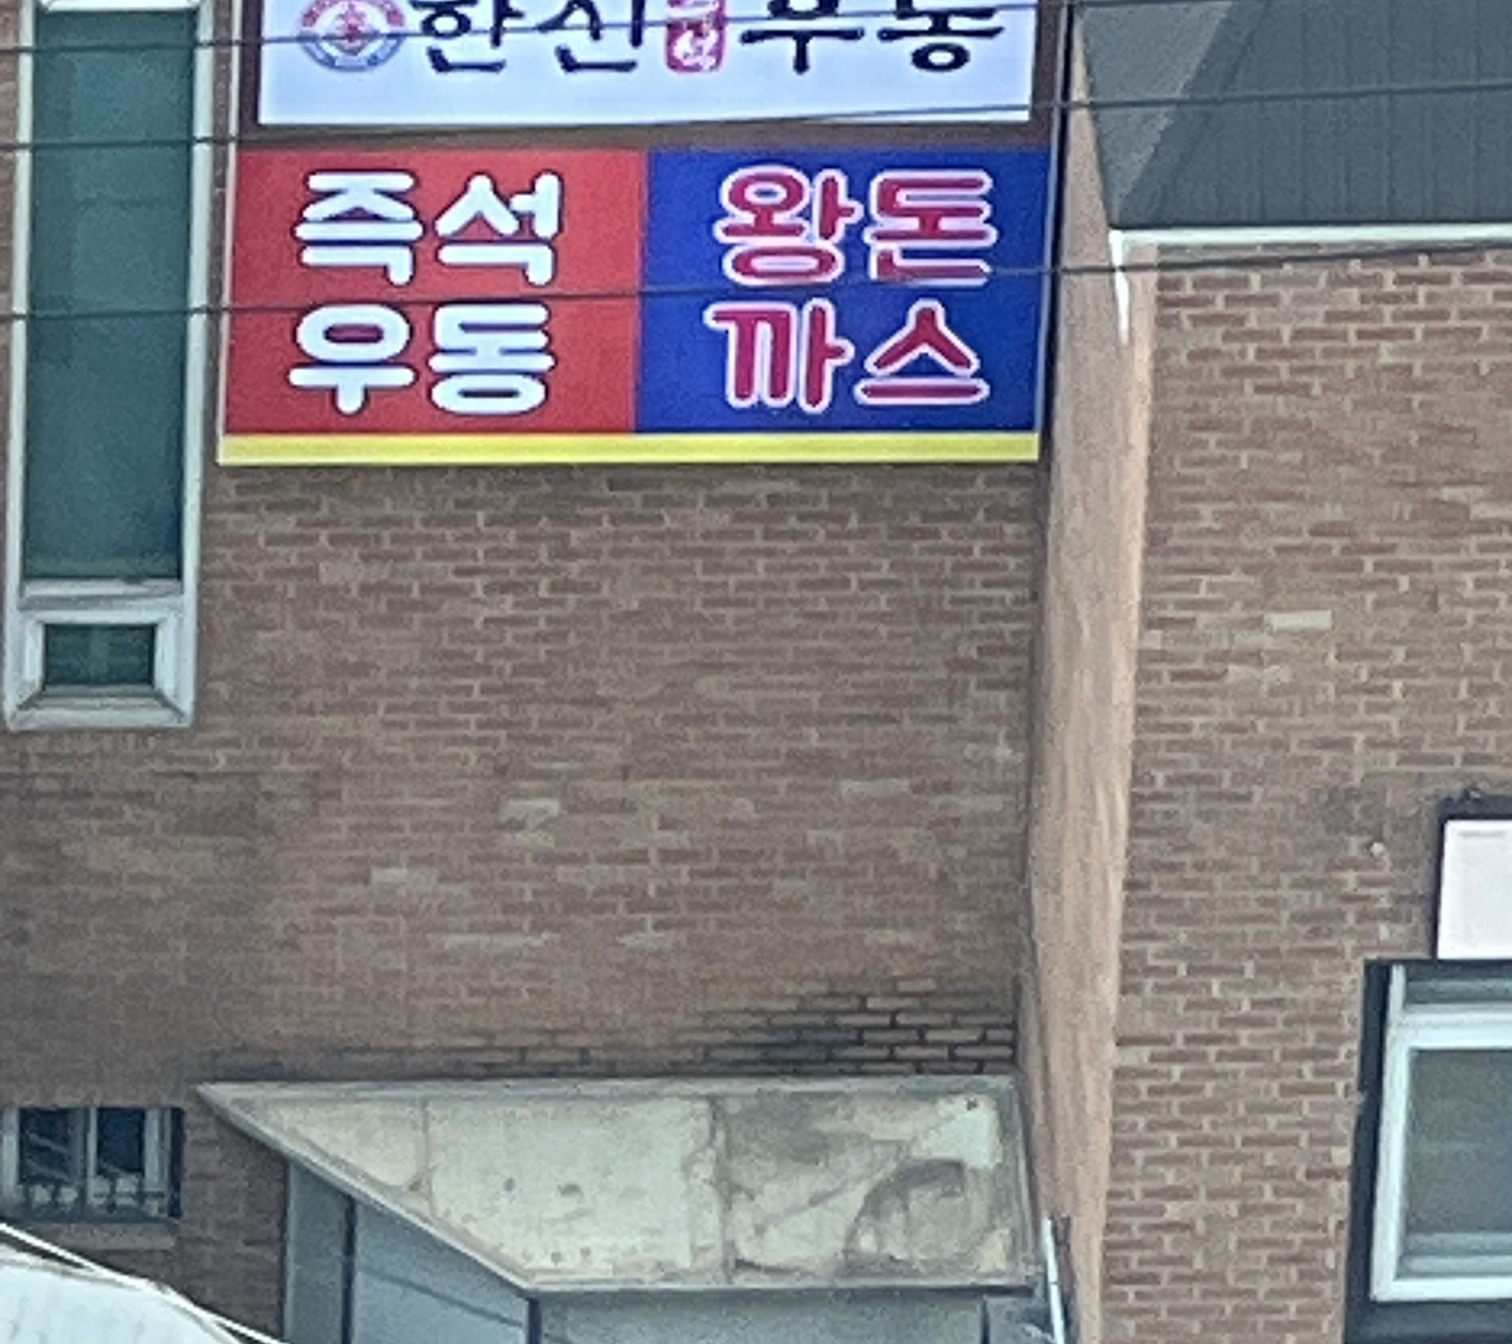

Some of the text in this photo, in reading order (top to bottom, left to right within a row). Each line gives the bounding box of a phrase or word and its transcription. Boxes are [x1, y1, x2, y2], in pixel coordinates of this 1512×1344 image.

[294, 167, 565, 287] 즉석
[713, 162, 999, 287] 왕돈
[287, 301, 557, 417] 우동
[702, 297, 991, 413] 까스
